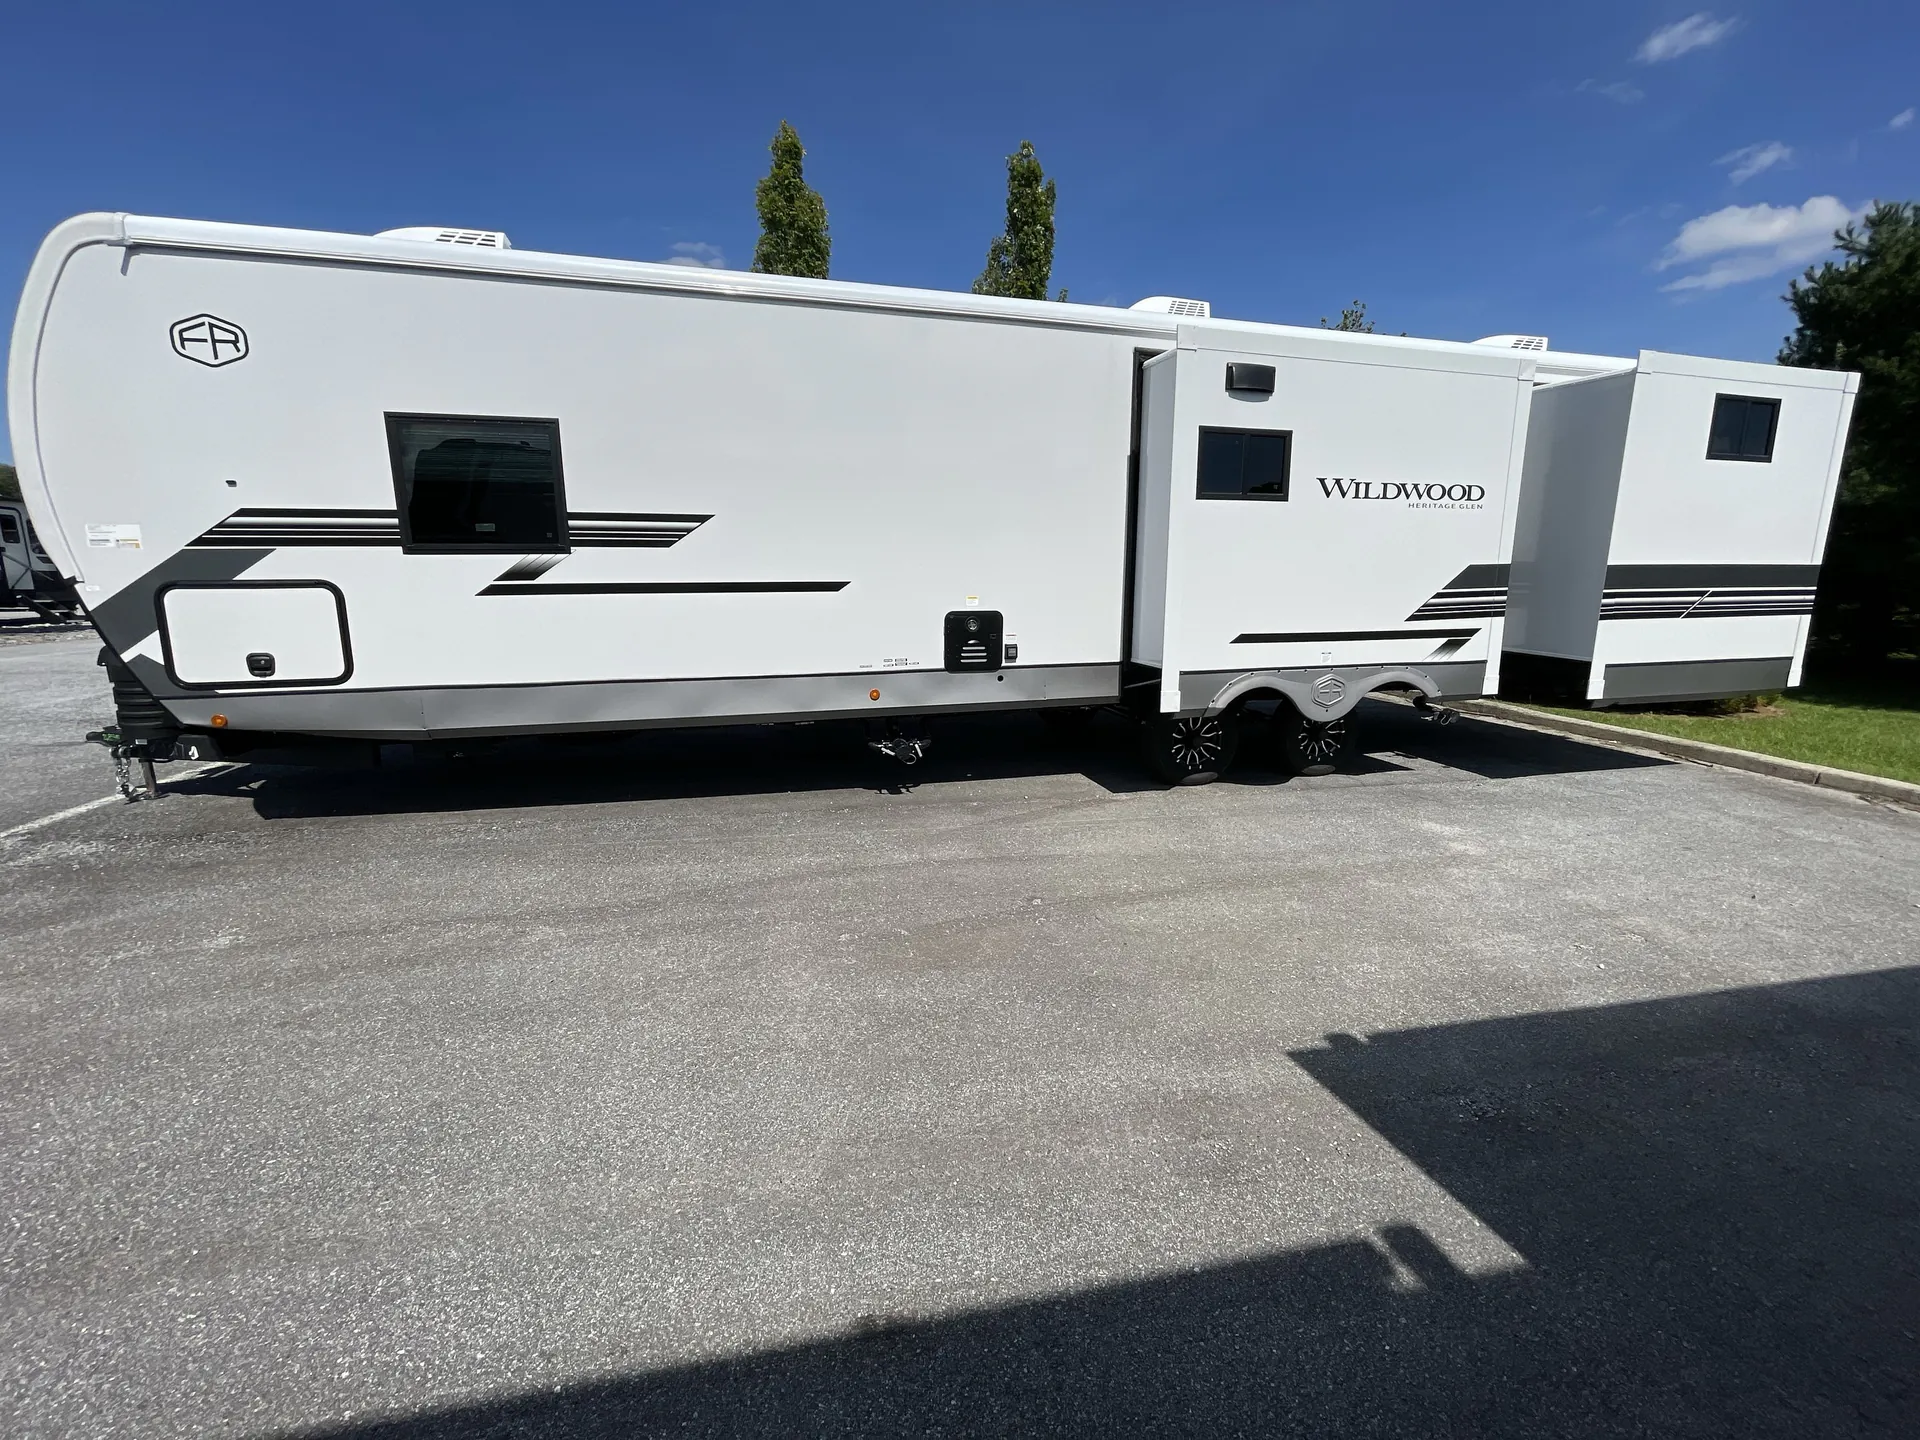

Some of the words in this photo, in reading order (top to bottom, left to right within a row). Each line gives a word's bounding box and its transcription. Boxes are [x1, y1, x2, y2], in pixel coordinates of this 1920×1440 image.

[178, 320, 241, 361] FR
[1316, 477, 1486, 502] WILDWOOD
[1408, 502, 1457, 510] HERITAGE
